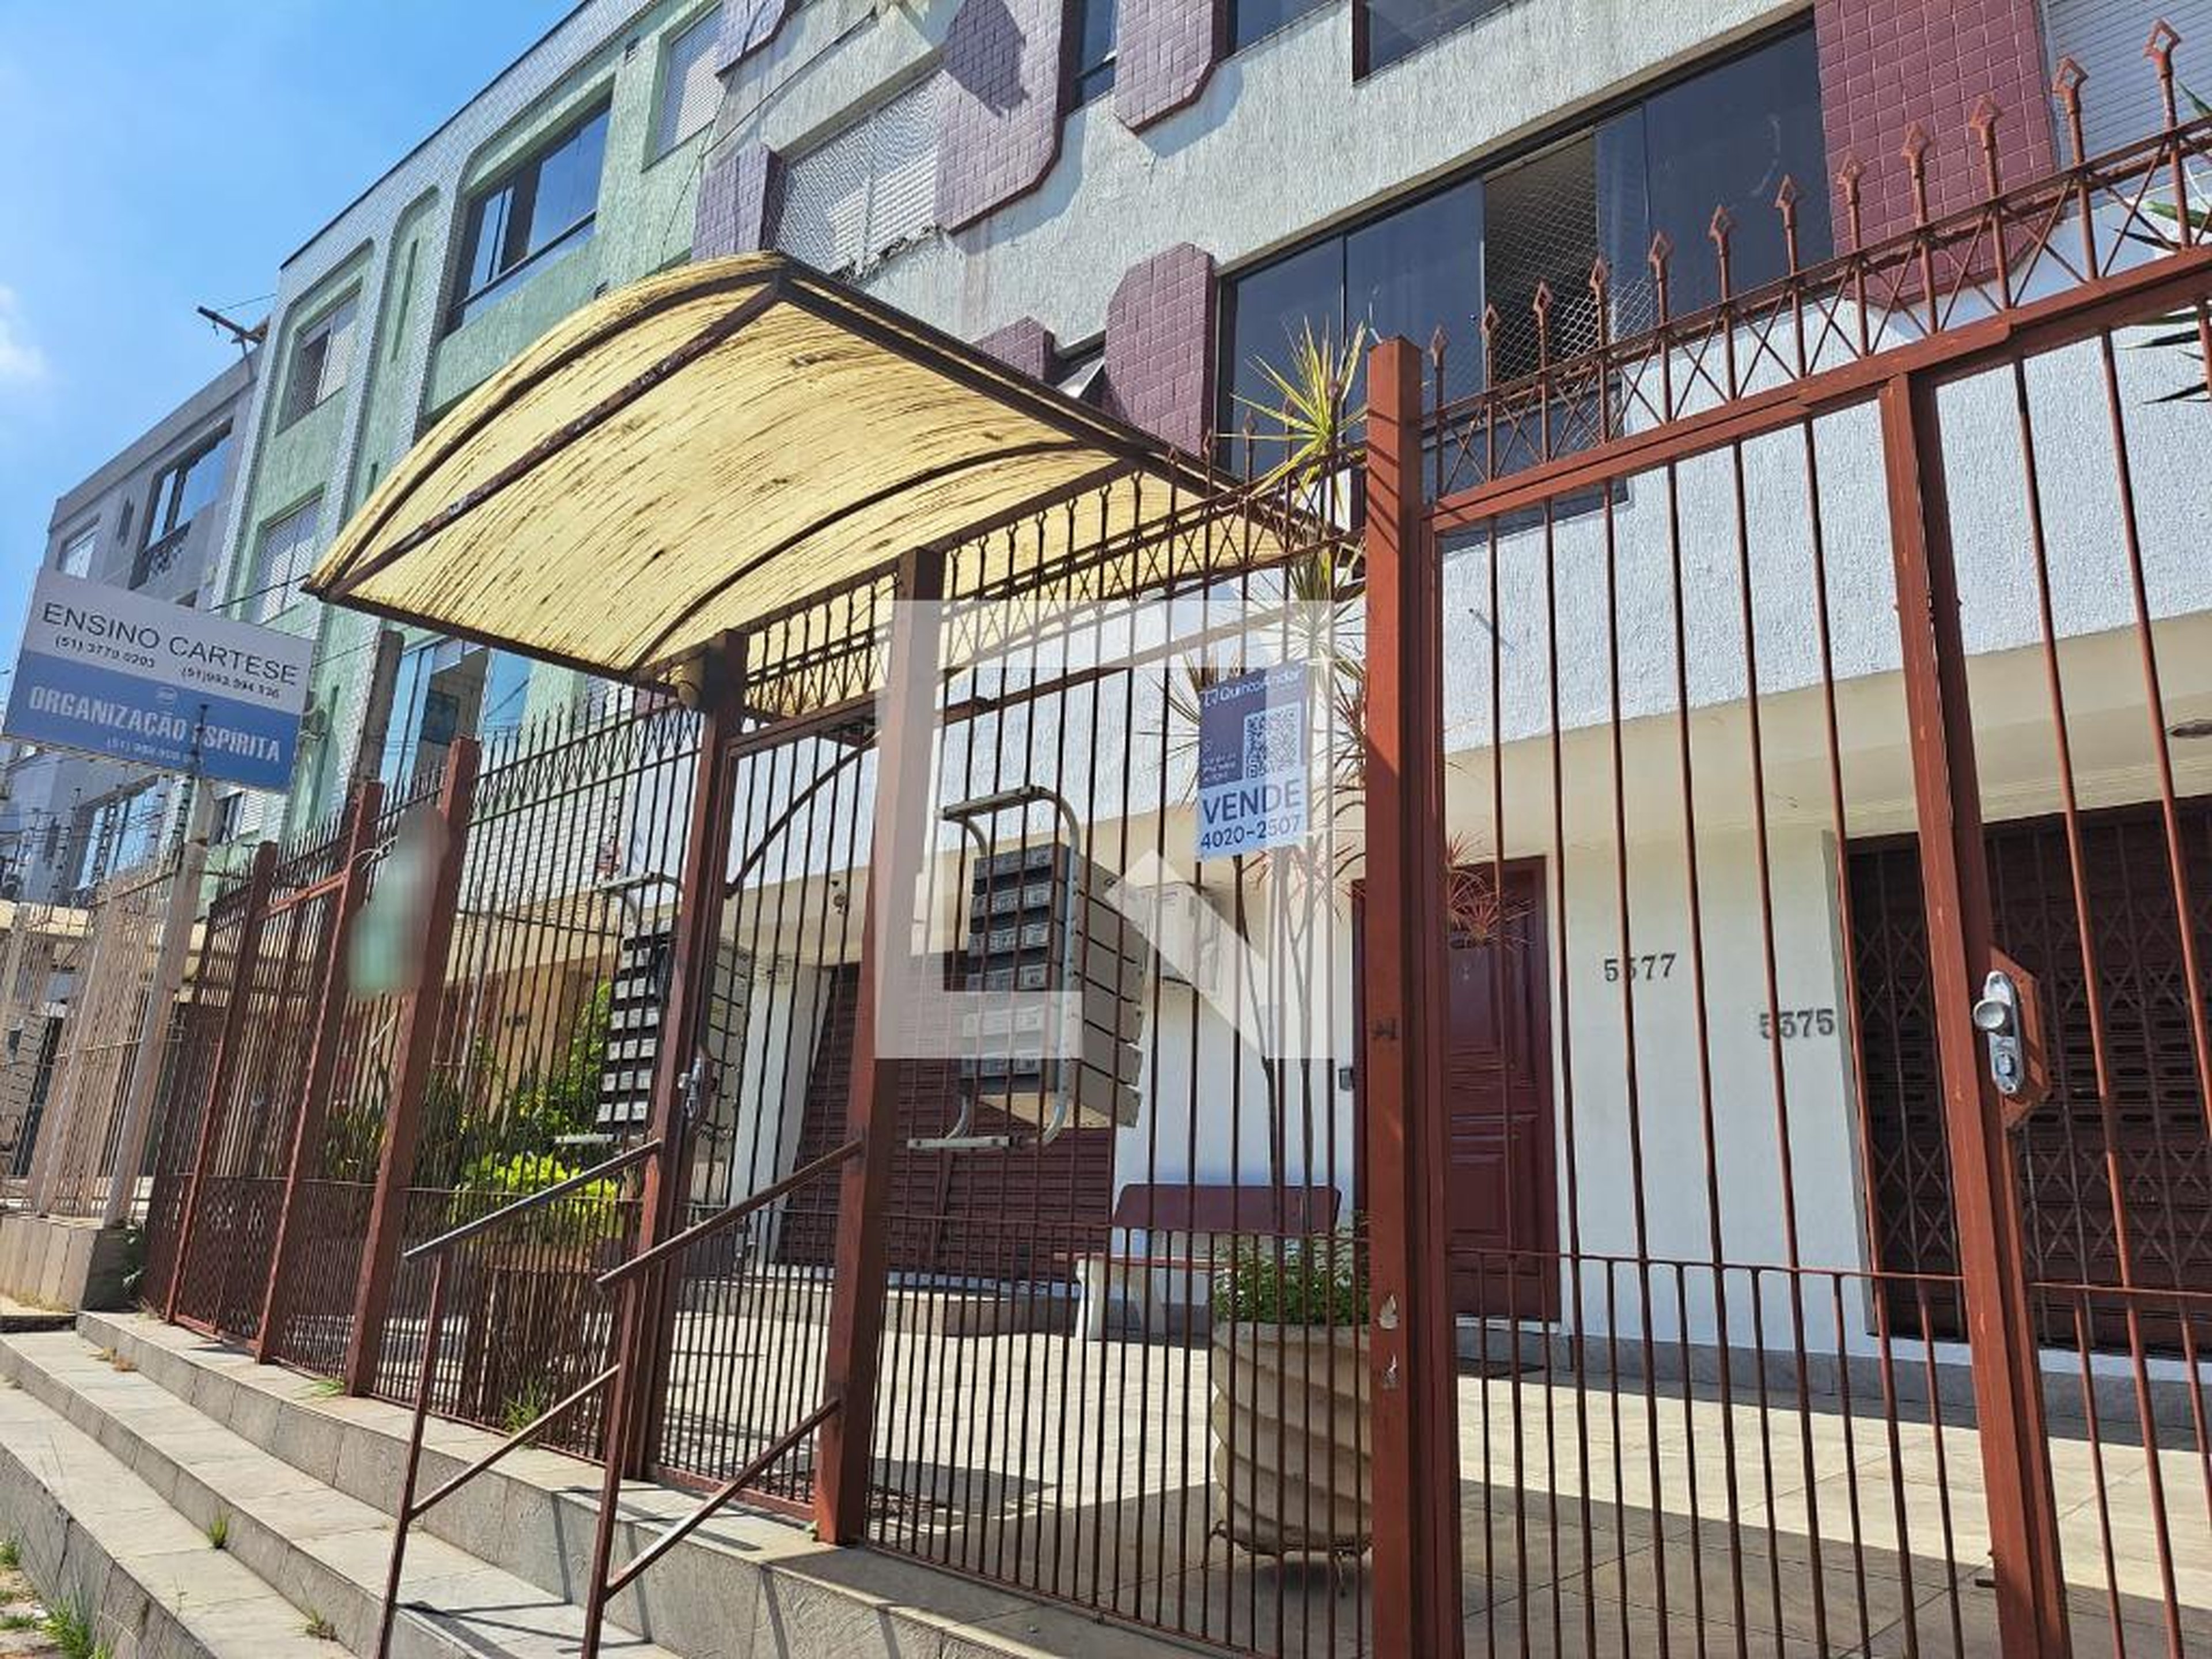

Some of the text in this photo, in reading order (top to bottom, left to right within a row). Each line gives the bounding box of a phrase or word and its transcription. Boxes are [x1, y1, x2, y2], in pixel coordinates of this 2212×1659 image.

[43, 601, 300, 685] ENSINO CARTESE
[28, 685, 187, 742] ORGANIZAÇÃO
[1202, 779, 1302, 824] VENDE
[1200, 815, 1302, 849] 4020-2507
